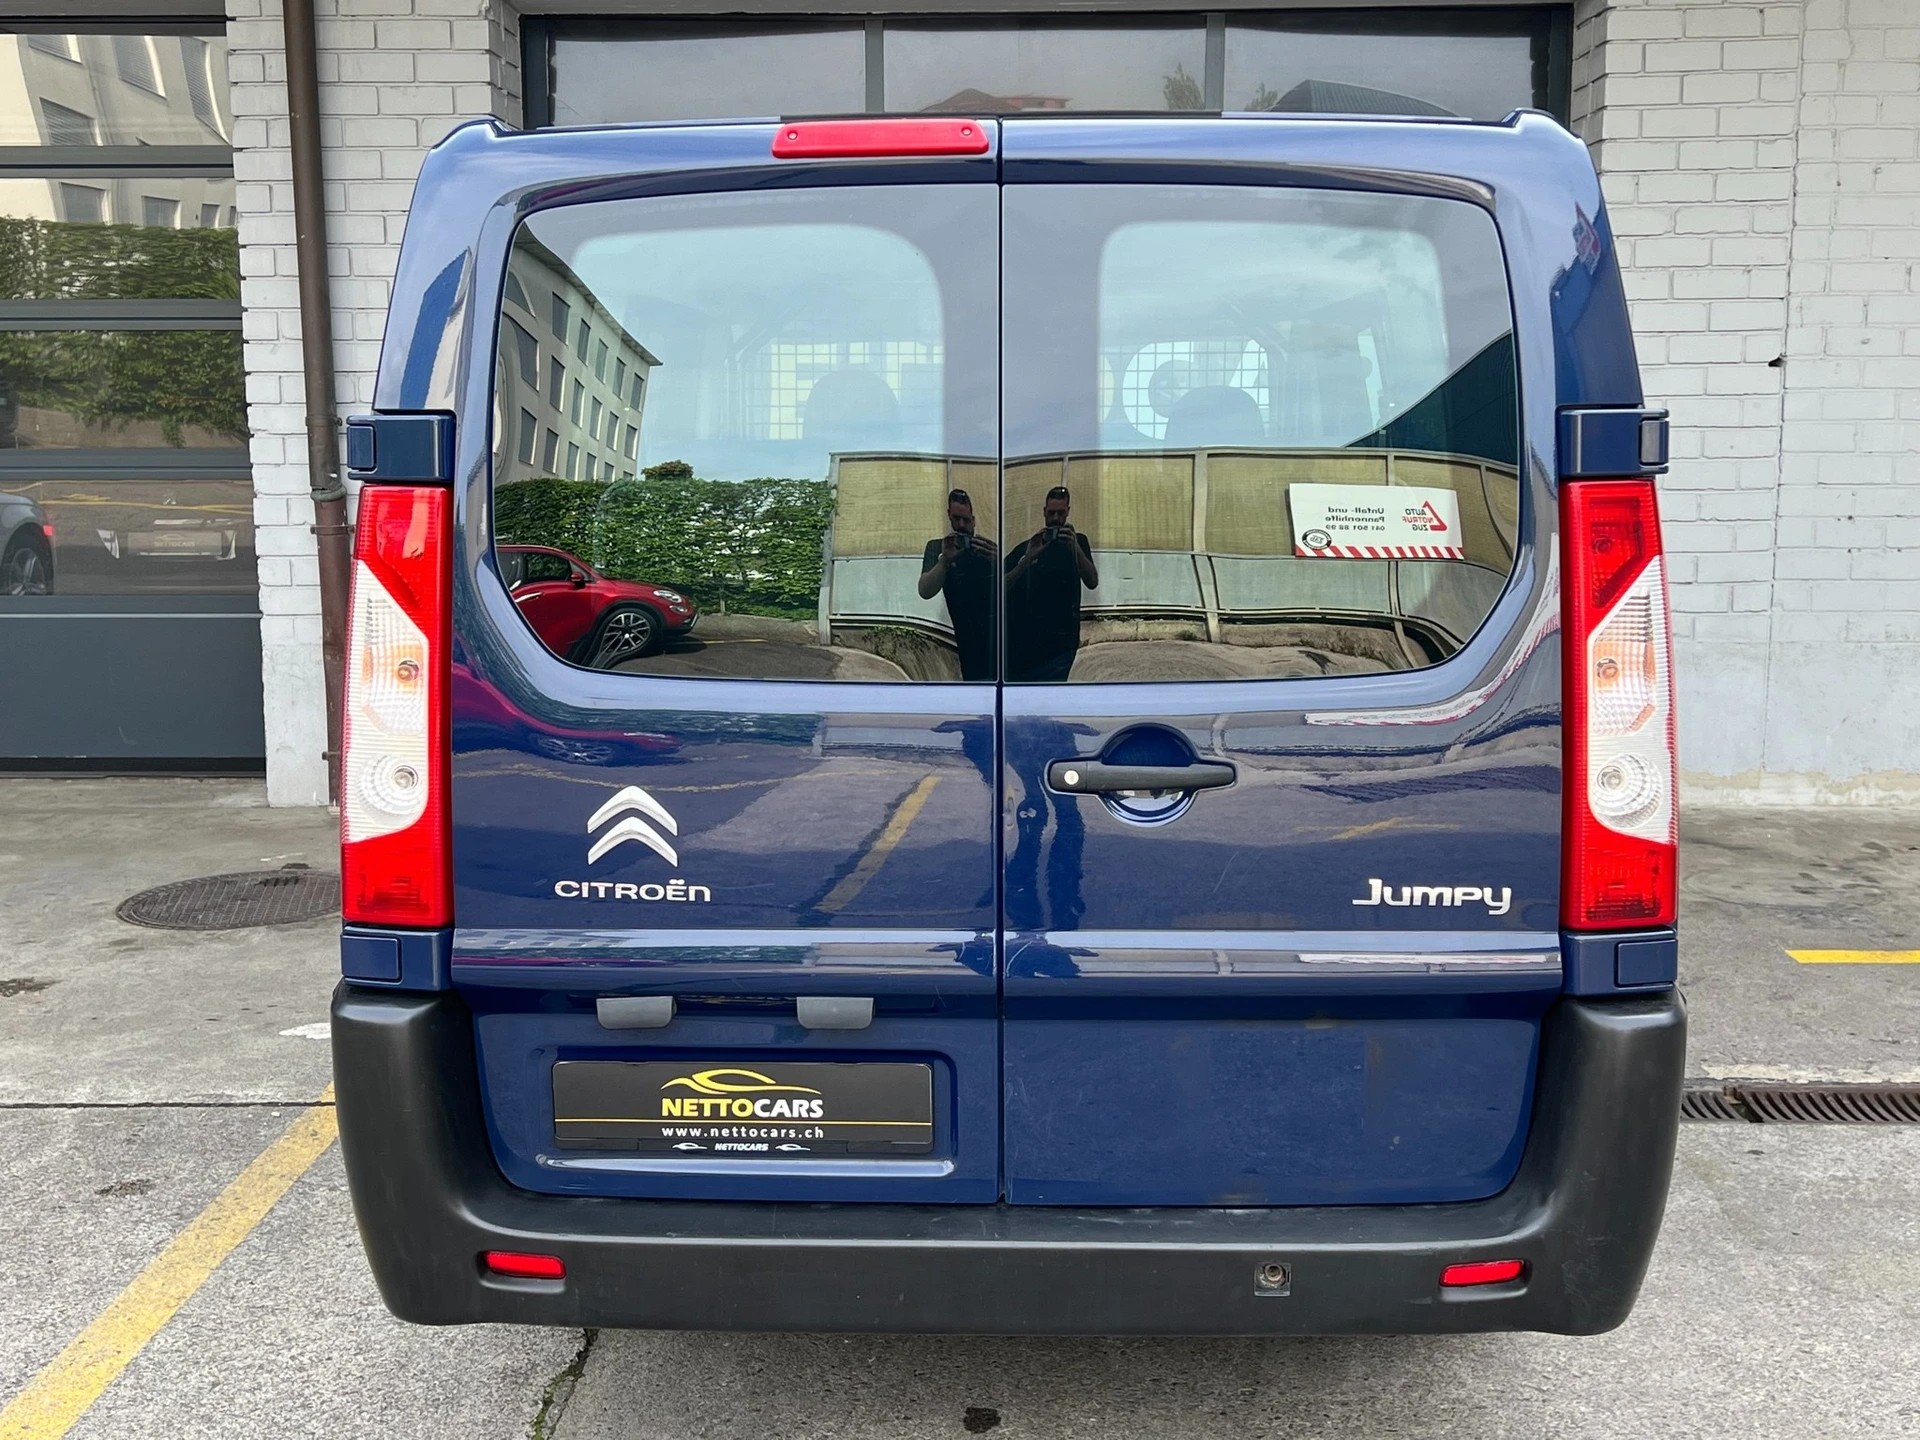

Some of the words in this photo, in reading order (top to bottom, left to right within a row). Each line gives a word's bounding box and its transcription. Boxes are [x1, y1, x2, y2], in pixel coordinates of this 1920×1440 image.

[1352, 878, 1512, 915] Jumpy
[661, 1097, 824, 1119] NETTOCARS
[661, 1125, 825, 1139] www.nettocars.ch
[714, 1142, 769, 1152] NETTOCARS
